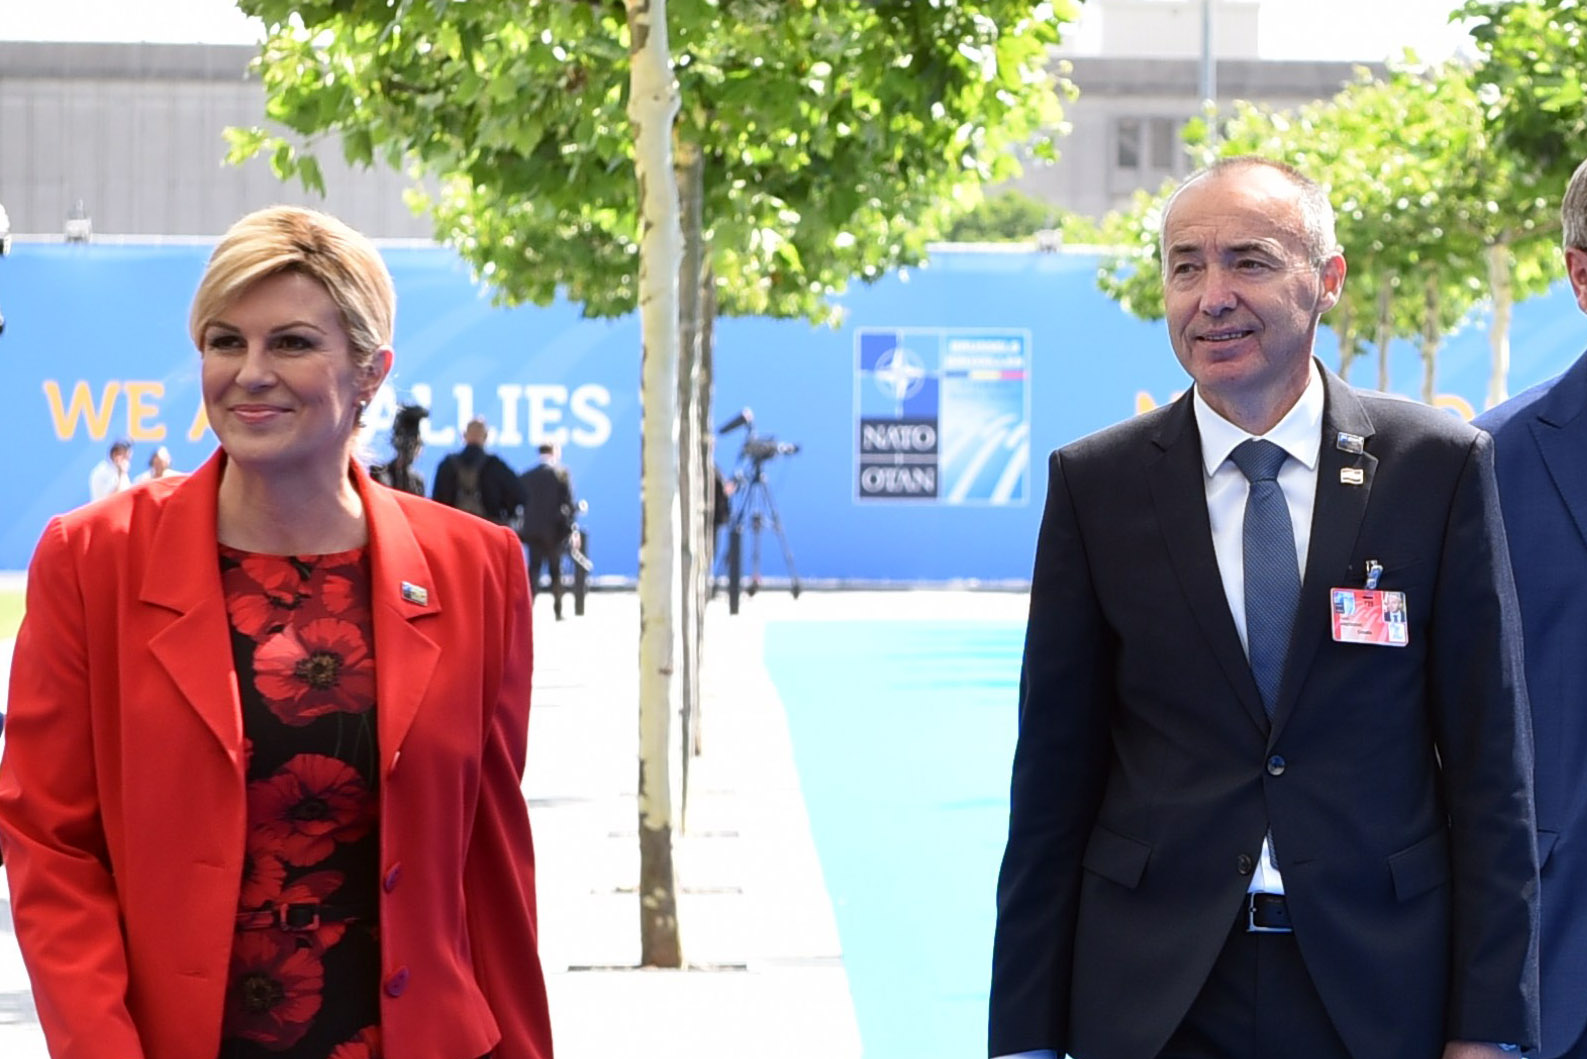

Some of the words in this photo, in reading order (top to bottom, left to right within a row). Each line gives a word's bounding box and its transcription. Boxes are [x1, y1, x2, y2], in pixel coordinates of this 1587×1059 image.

[43, 381, 167, 441] WE
[862, 423, 937, 452] NATO
[861, 465, 936, 493] OTAN
